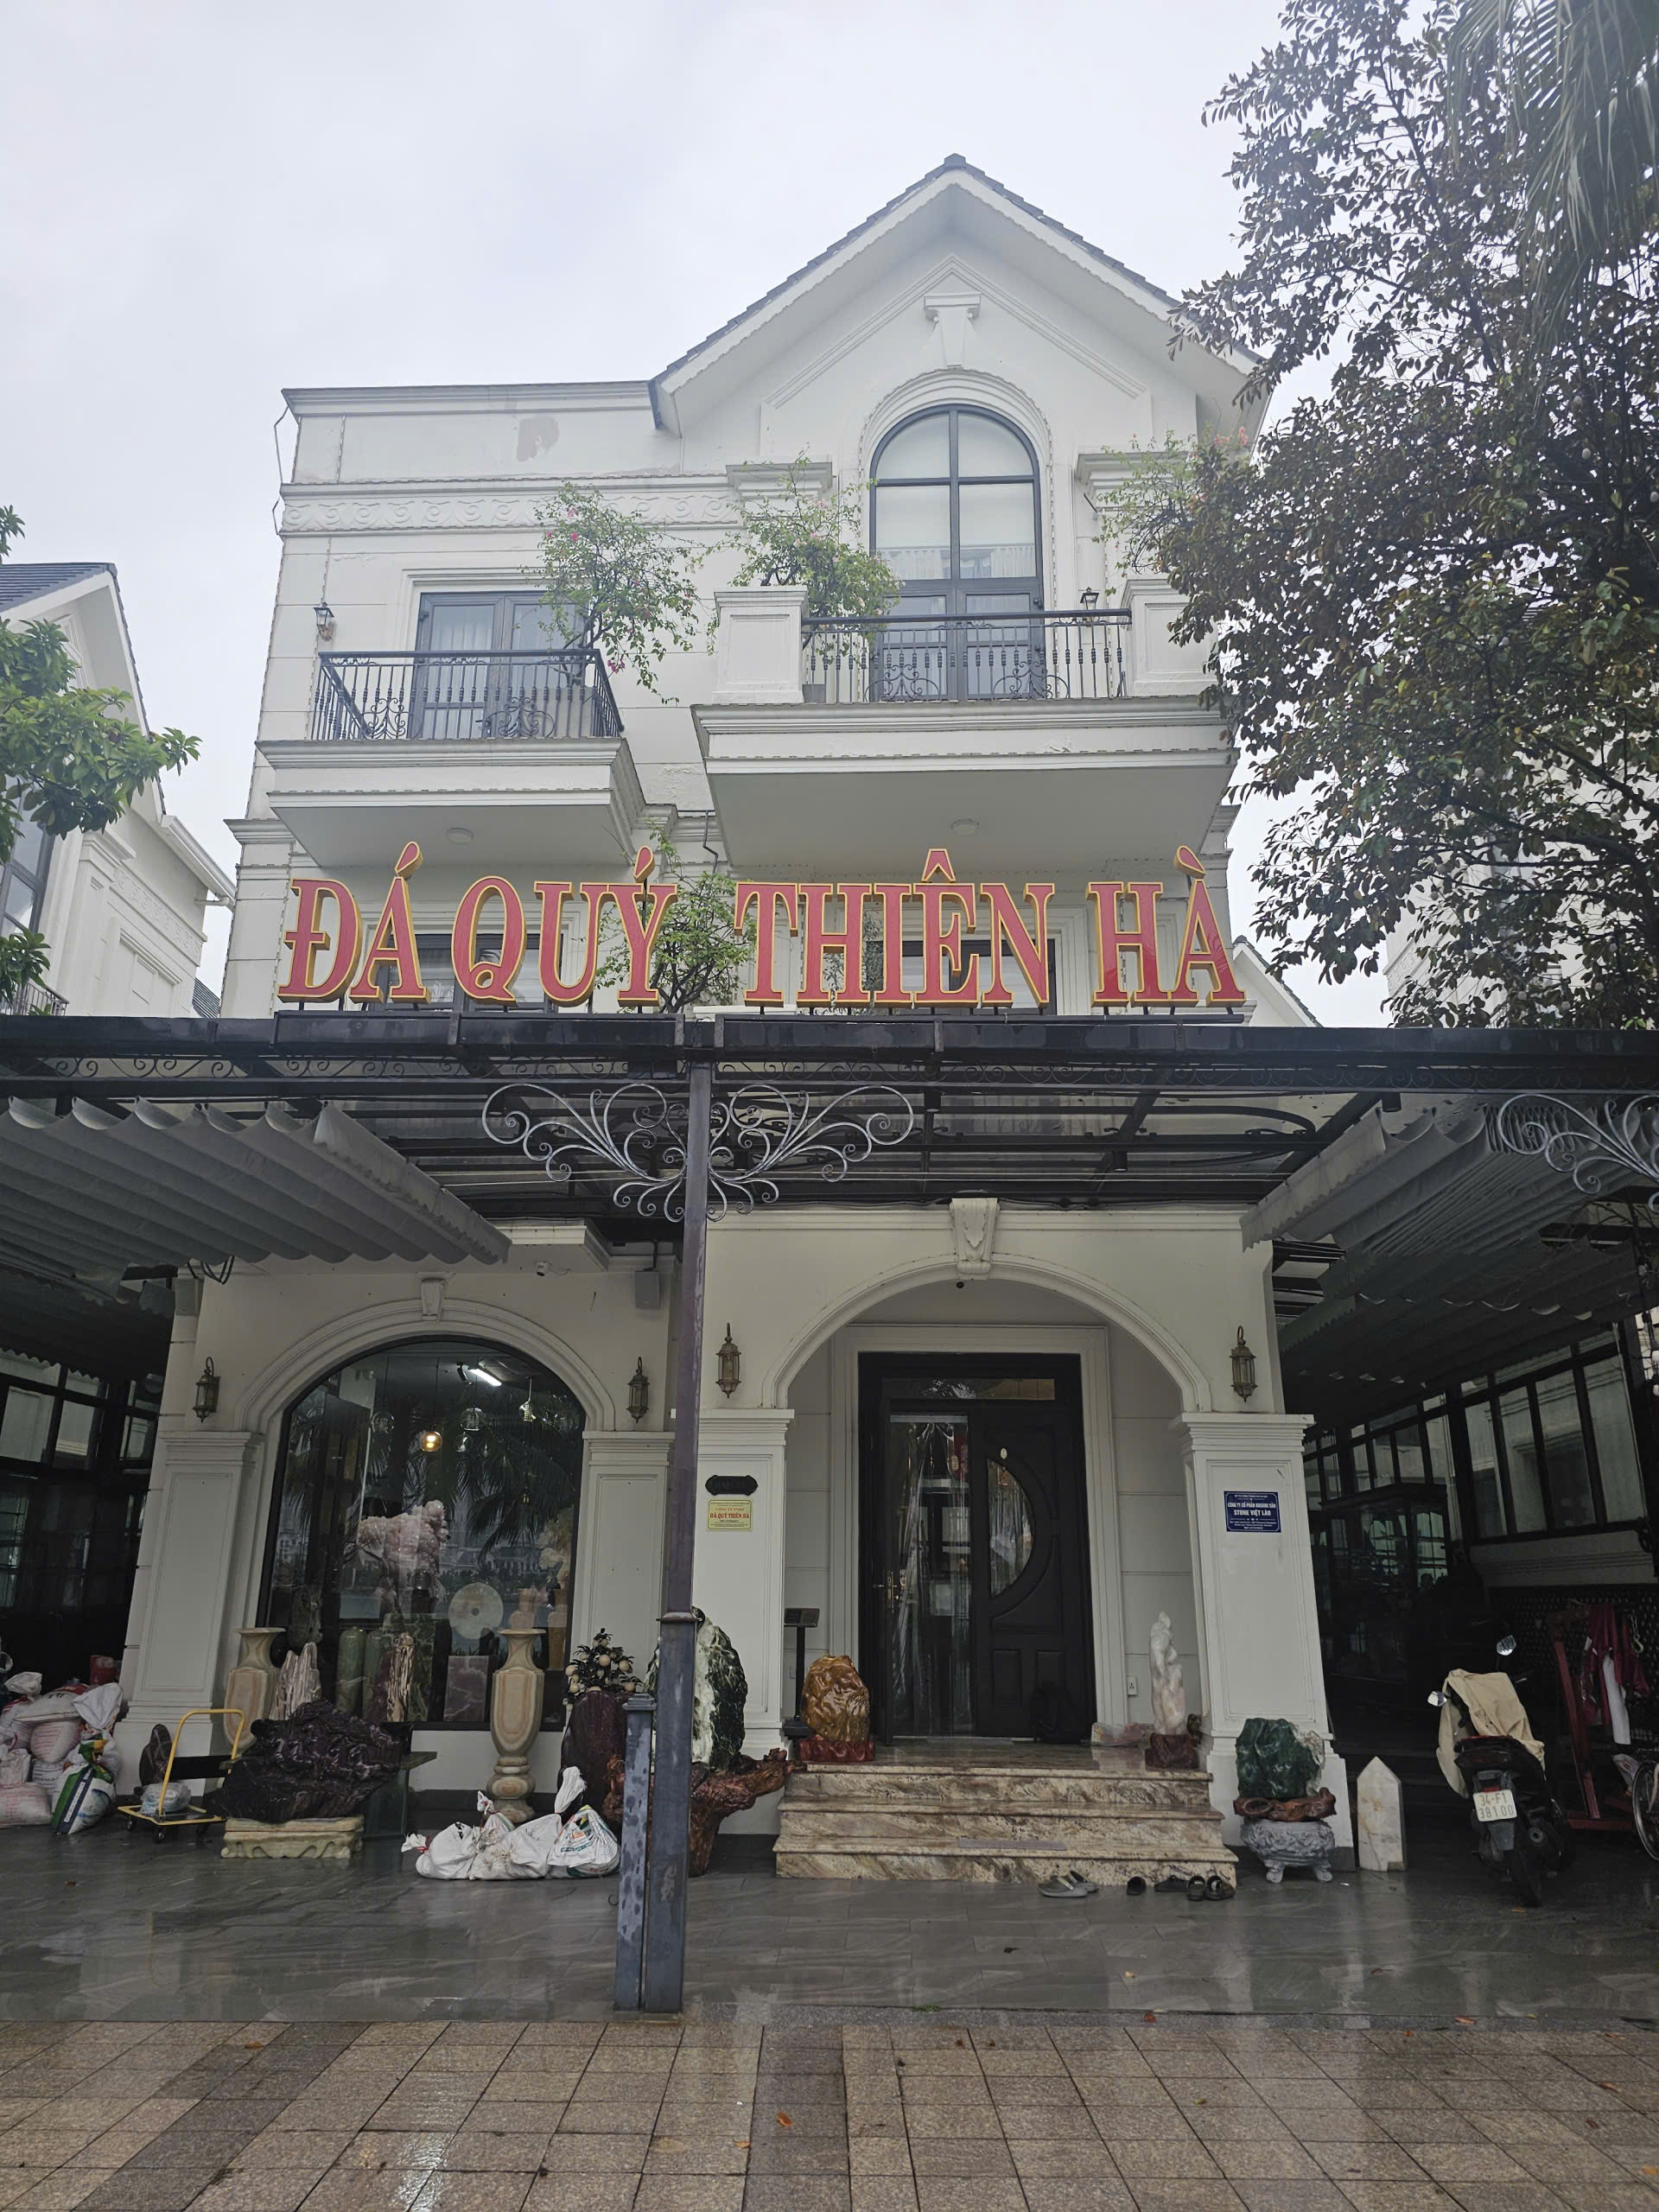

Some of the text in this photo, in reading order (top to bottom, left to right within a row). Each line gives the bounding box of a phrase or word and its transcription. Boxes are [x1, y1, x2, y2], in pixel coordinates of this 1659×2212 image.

[276, 842, 1247, 1008] ĐÁ QUÝ THIÊN HÀ
